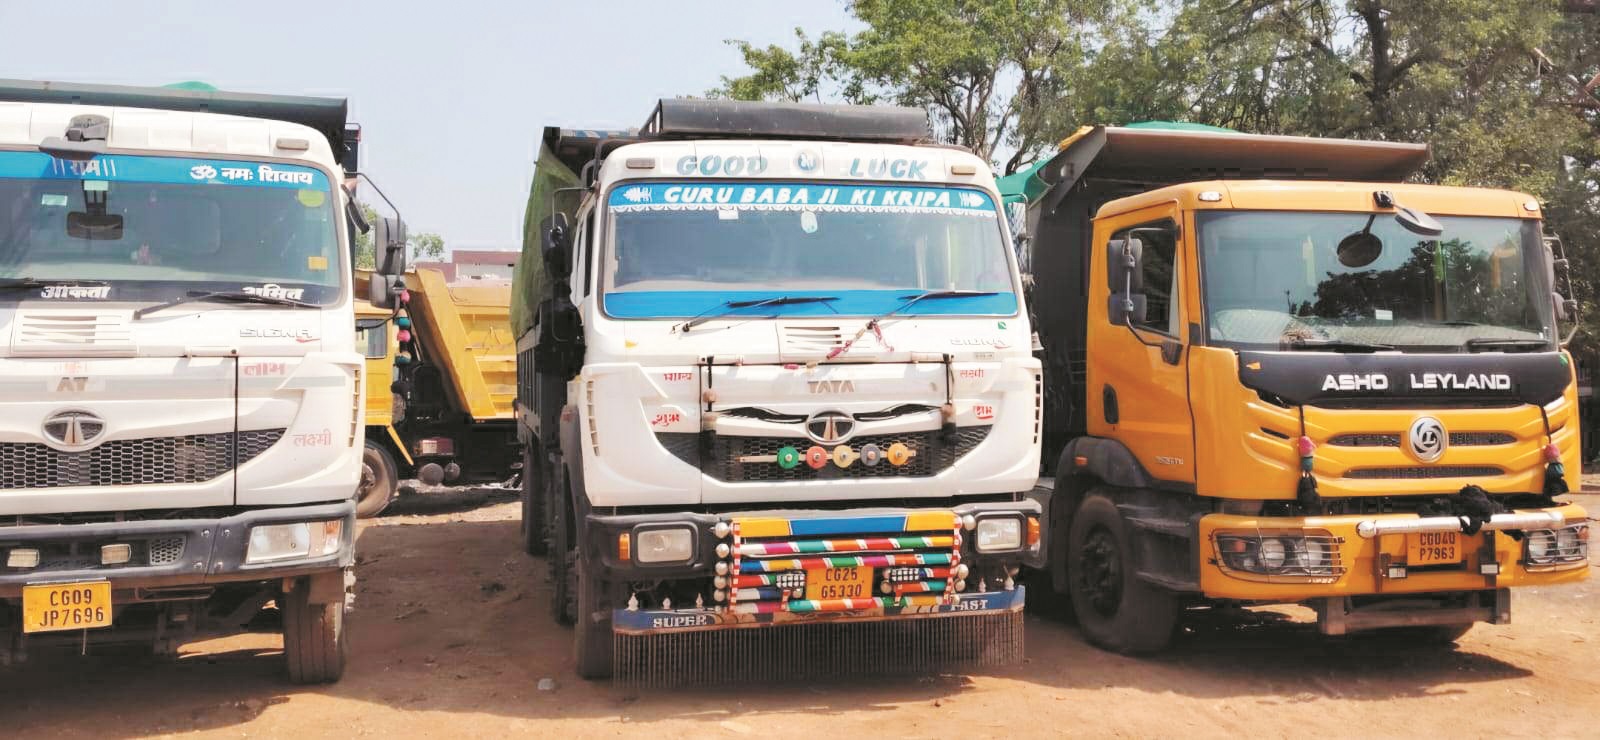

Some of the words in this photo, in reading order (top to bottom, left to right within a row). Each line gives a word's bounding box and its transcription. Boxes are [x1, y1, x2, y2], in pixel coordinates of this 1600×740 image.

[258, 165, 313, 185] शिवाय
[676, 154, 768, 176] GOOD
[850, 157, 928, 179] LUCK
[664, 186, 734, 204] GURU
[740, 187, 808, 204] BABA
[818, 188, 838, 204] JI
[851, 190, 875, 206] KI
[882, 190, 950, 207] KRIPA
[807, 379, 855, 393] TATA
[1322, 374, 1389, 391] ASHO
[1410, 373, 1511, 390] LEYLAND
[1419, 546, 1455, 560] P7963
[50, 589, 92, 606] CG09
[39, 607, 104, 627] JP7696
[653, 614, 707, 628] SUPER
